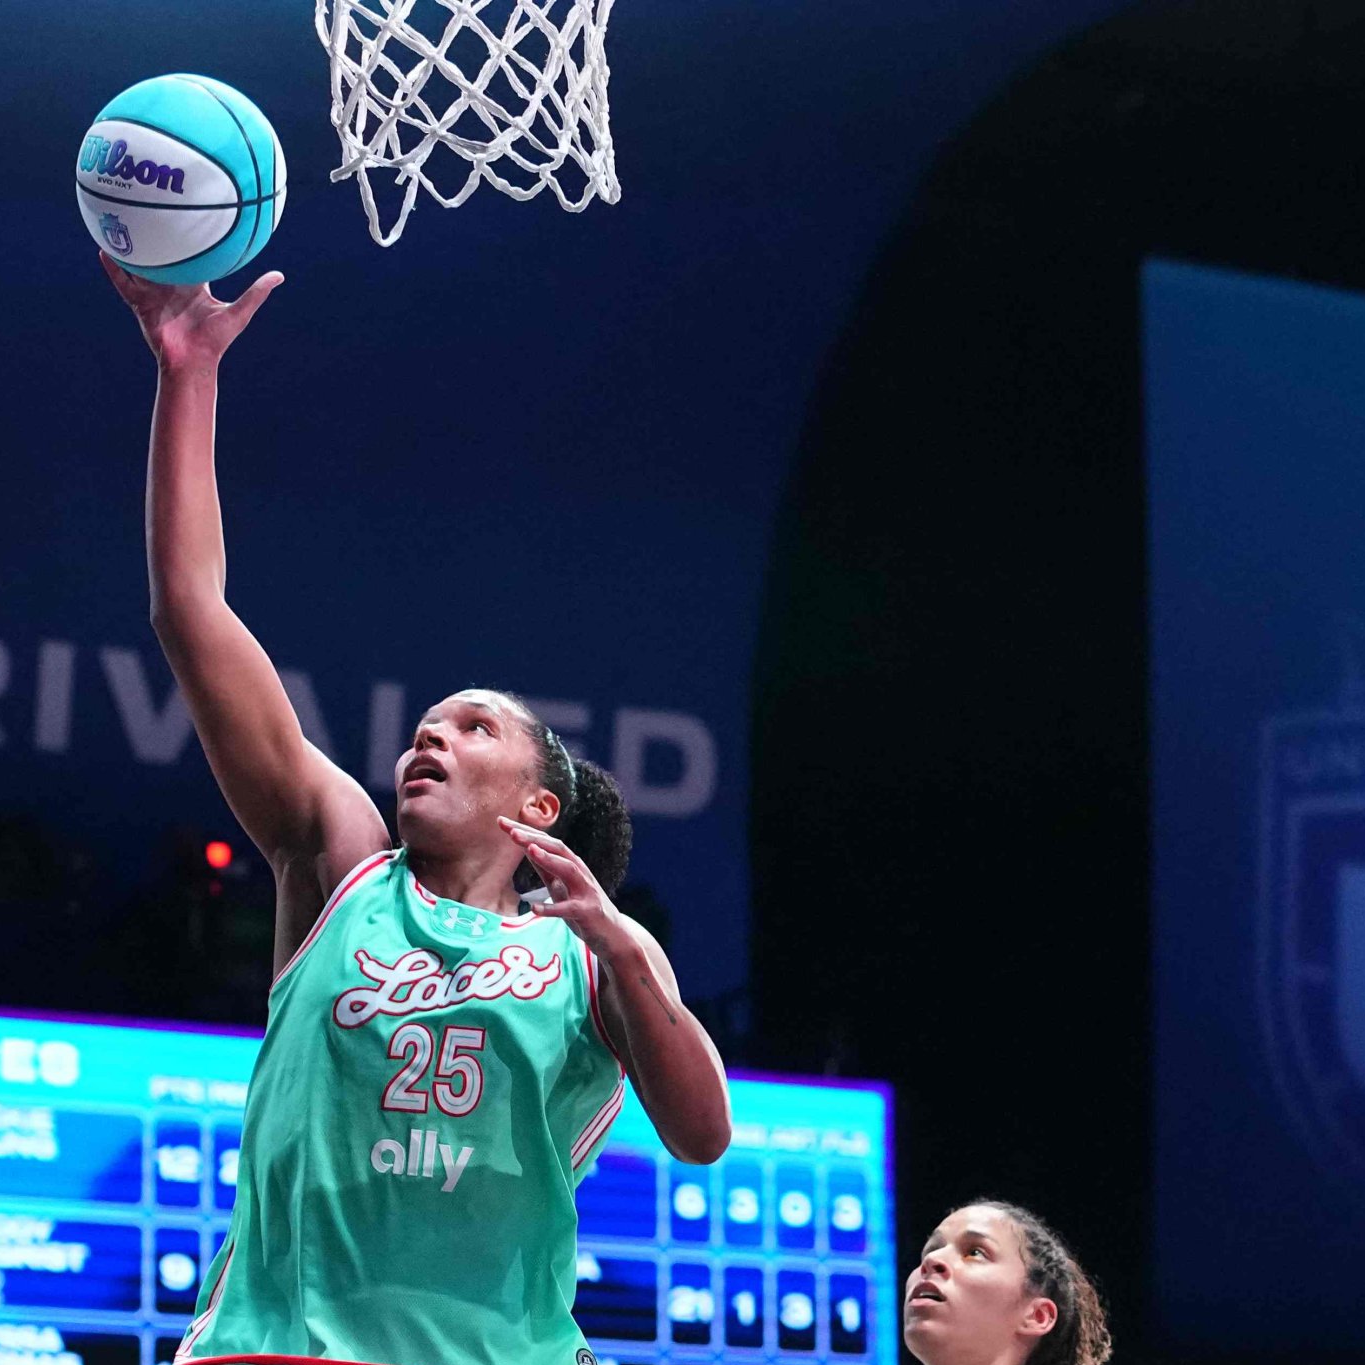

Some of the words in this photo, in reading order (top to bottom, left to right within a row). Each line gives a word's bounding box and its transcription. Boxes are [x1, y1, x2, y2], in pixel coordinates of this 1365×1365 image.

[79, 136, 185, 194] Wilson
[115, 181, 133, 190] NXT
[333, 945, 561, 1029] Laces
[381, 1022, 486, 1117] 25
[371, 1129, 474, 1193] ally
